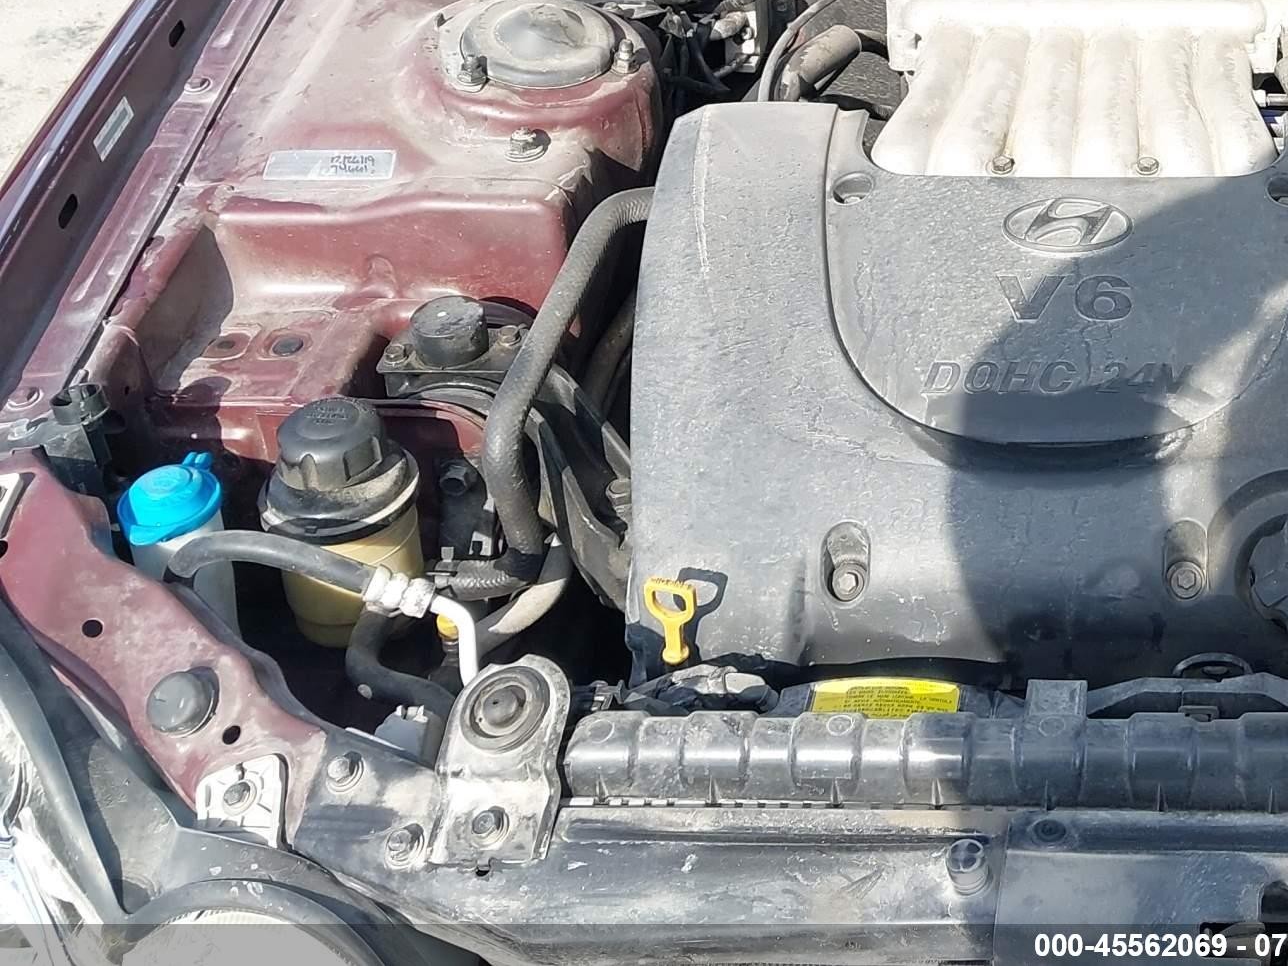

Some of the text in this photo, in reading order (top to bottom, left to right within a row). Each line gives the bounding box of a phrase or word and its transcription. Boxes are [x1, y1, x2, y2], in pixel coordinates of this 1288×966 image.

[996, 274, 1133, 322] V6
[921, 360, 1194, 395] DOHC 24V
